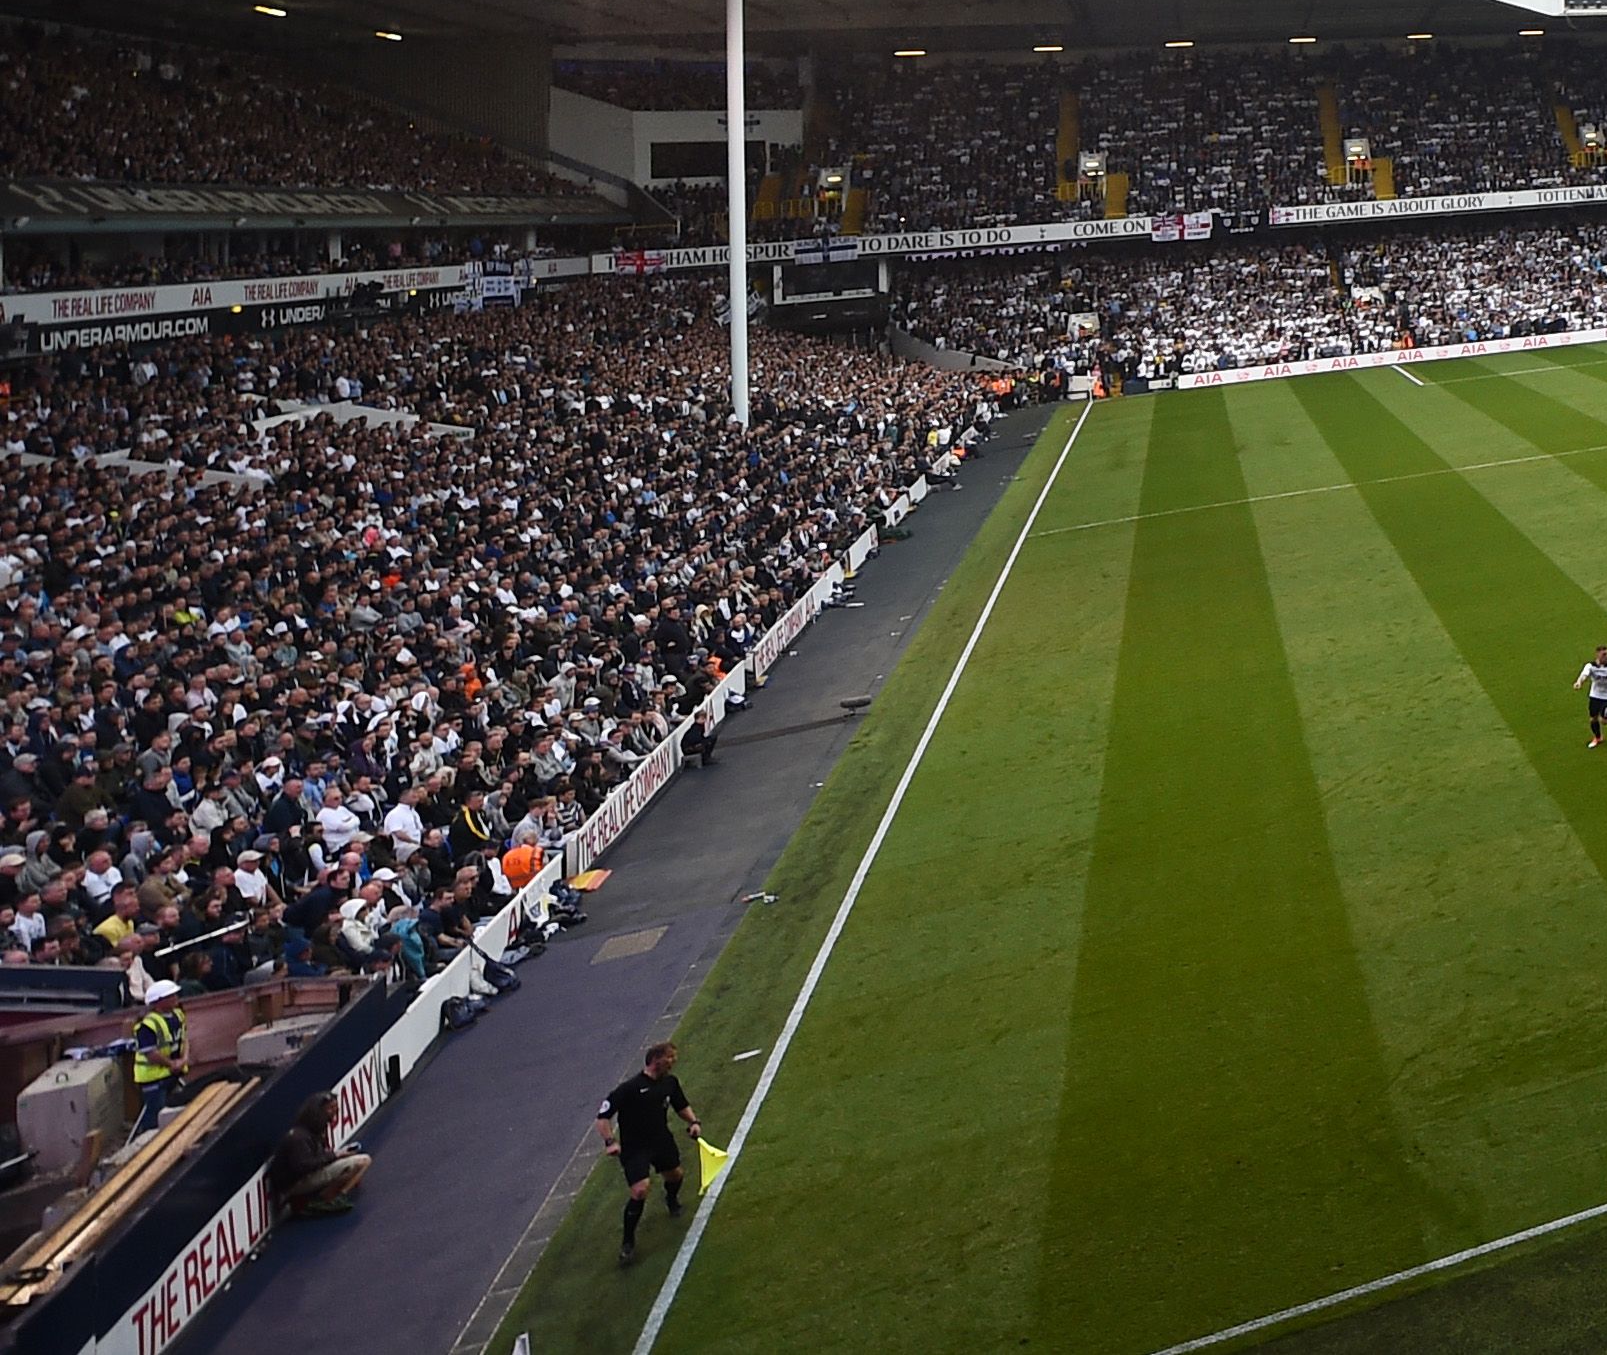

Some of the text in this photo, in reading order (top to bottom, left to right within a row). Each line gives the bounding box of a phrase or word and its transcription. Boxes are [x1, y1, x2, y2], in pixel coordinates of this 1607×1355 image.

[1294, 195, 1486, 221] THE GAME IS ABOUT GLORY
[1073, 219, 1147, 237] COME ON
[860, 237, 882, 252] TO
[888, 234, 935, 250] DARE
[940, 232, 953, 246] IS
[959, 231, 981, 245] TO
[987, 229, 1011, 243] DO
[713, 244, 790, 264] HOSPUR
[191, 286, 212, 306] AIA
[257, 282, 273, 301] REAL
[274, 281, 288, 300] LIFE
[288, 279, 320, 299] COMPANY
[52, 291, 156, 318] THE REAL LIFE COMPANY
[40, 316, 209, 352] UNDERARMOUR.COM
[1523, 337, 1548, 348] AIA
[1398, 350, 1424, 361] AIA
[1461, 343, 1487, 355] AIA
[1263, 364, 1292, 377] AIA
[1331, 357, 1359, 369] AIA
[1194, 373, 1223, 386] AIA
[598, 745, 671, 845] REAL LIFE COMPANY
[132, 1269, 181, 1355] THE
[183, 1207, 245, 1317] REAL
[325, 1062, 376, 1152] PANY
